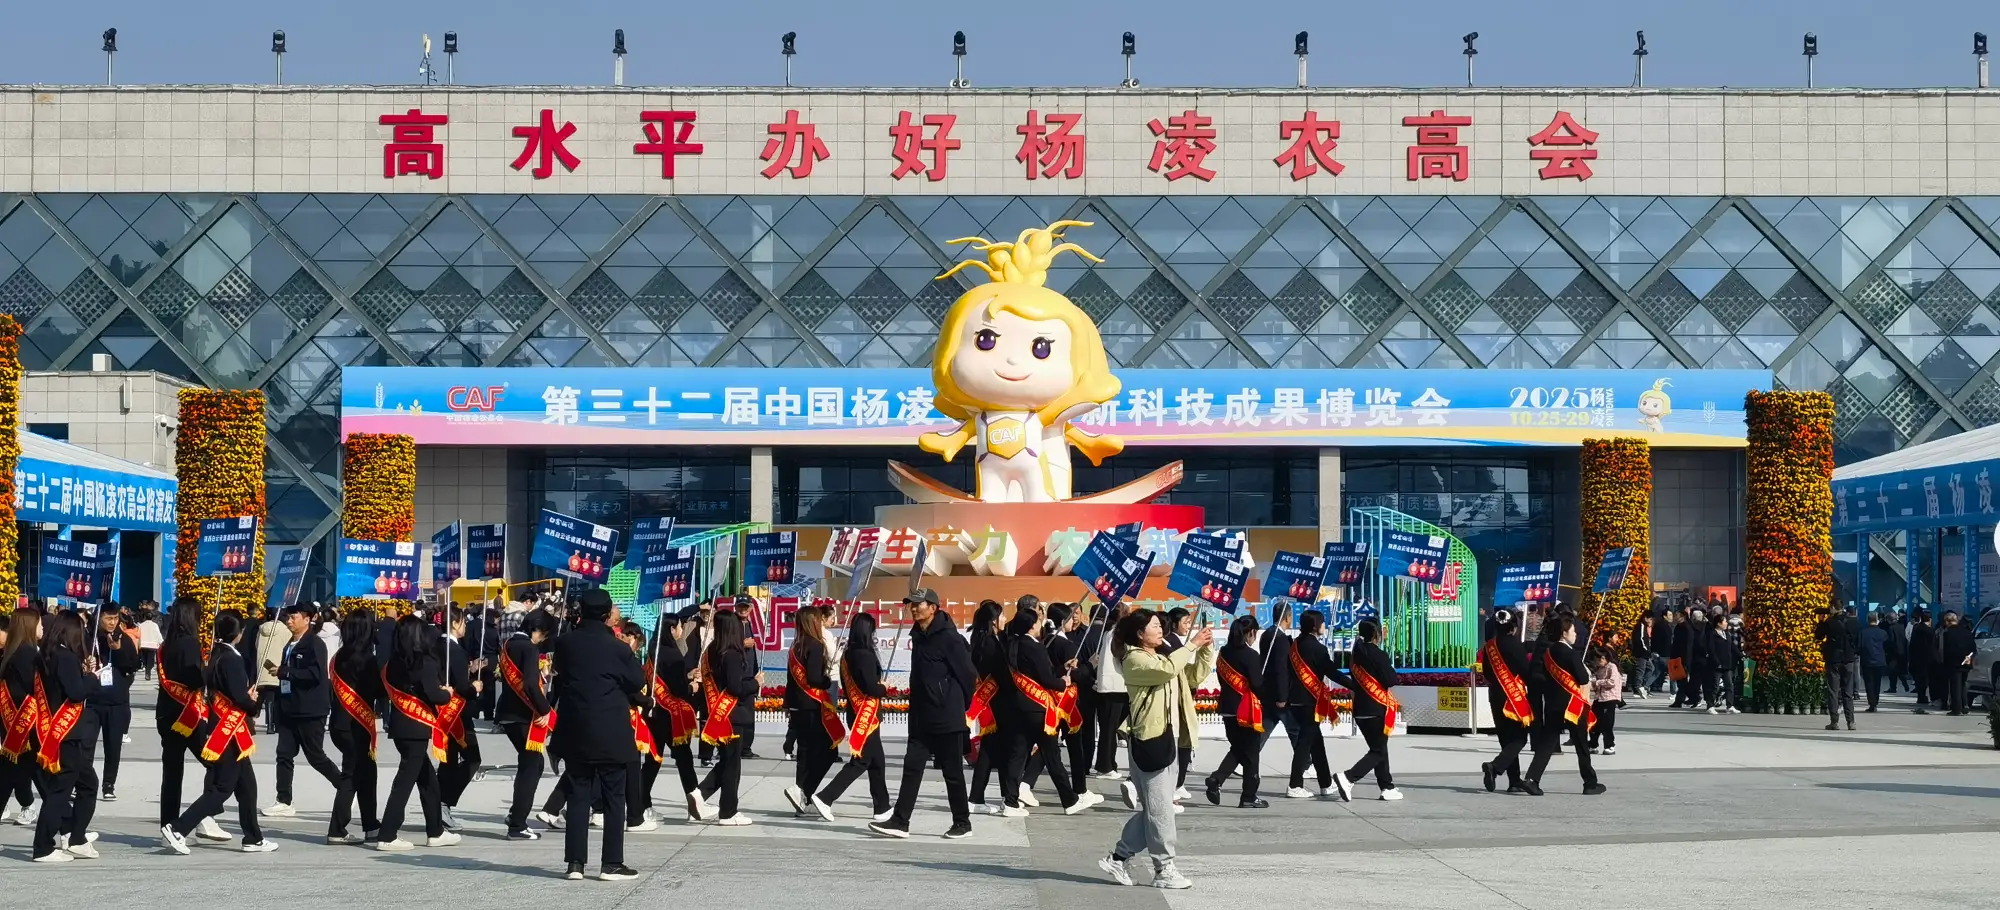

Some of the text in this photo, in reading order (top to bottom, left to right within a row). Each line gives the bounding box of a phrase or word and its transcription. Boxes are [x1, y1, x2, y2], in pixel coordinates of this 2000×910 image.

[379, 109, 1599, 181] 高水平办好杨凌农高会
[447, 386, 504, 411] CAF
[541, 385, 1452, 427] 第三十二届中国杨凌新科技成果博览会
[1509, 387, 1588, 409] 2025
[1591, 387, 1605, 427] 杨凌
[1605, 388, 1614, 427] YANGLING
[991, 427, 1023, 444] CAF
[1510, 411, 1590, 426] 10.25-29
[14, 469, 178, 525] 第三十二届中国杨凌农高会路演发
[831, 525, 1008, 566] 新质生产力
